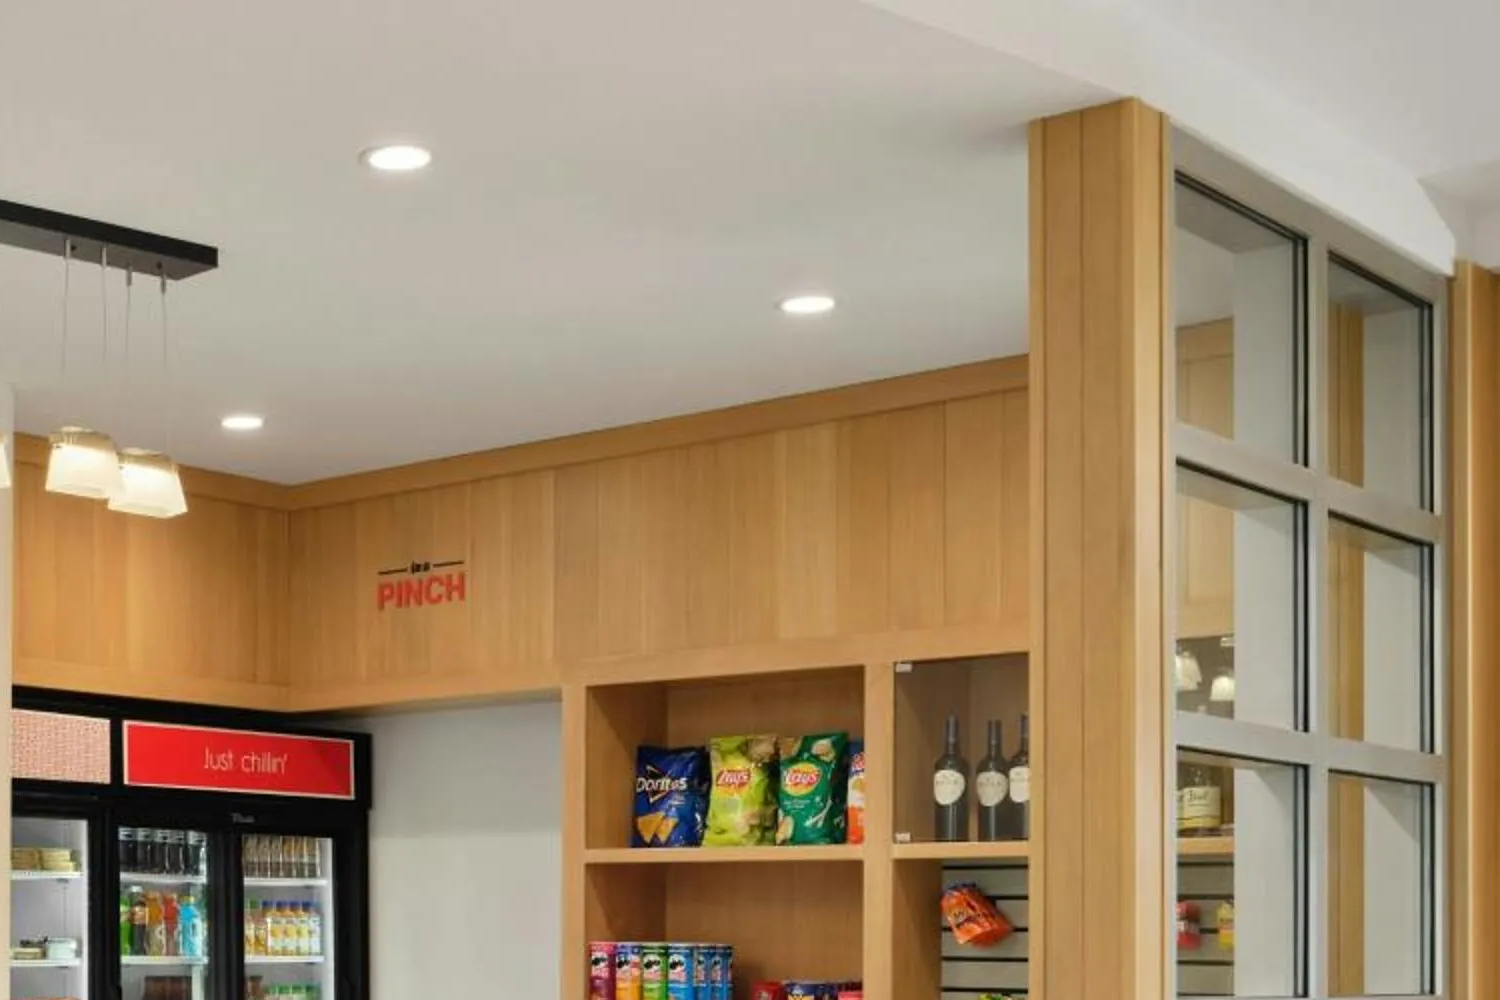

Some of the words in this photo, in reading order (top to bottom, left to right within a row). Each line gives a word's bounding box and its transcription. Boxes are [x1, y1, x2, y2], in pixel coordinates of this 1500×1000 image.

[377, 571, 466, 612] PINCH
[203, 745, 234, 772] Just
[636, 776, 688, 793] Doritos
